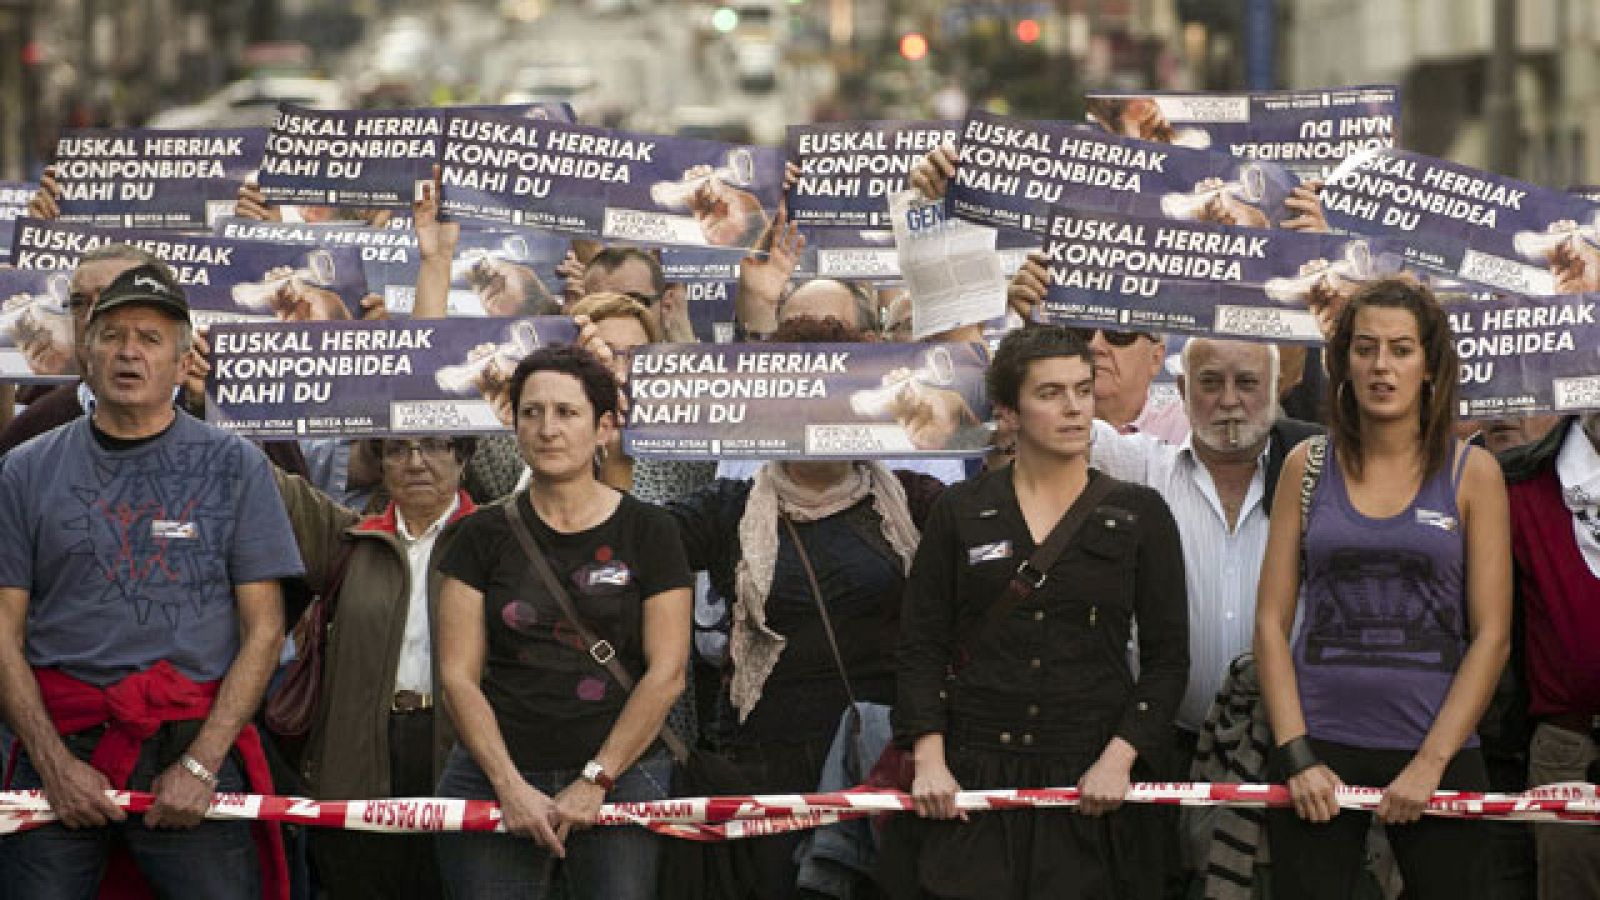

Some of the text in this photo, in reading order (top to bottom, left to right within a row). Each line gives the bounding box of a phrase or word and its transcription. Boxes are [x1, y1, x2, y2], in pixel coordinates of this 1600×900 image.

[275, 113, 443, 136] USKAL HERRIA
[1300, 115, 1393, 138] NAHI DU
[56, 137, 243, 156] EUSKAL HERRIAK
[448, 117, 655, 162] EUSKAL HERRIAK
[800, 129, 956, 154] EUSKAL HERR
[965, 120, 1168, 173] EUSKAL HERRIAK
[55, 159, 226, 179] KONPONBIDEA
[327, 160, 362, 179] DU
[444, 141, 630, 184] KONPONBIDEA
[800, 154, 920, 176] KONPON
[959, 144, 1141, 194] KONPONBIDEA
[59, 181, 115, 201] NAHI
[121, 181, 155, 201] DU
[441, 166, 551, 198] NAHI DU
[797, 178, 860, 197] NAHI
[955, 166, 1063, 204] NAHI DU
[1422, 166, 1528, 211] HERRIAK
[1319, 189, 1421, 231] NAHI DU
[1341, 171, 1497, 229] ONPONBIDEA
[223, 223, 419, 248] EUSKAL HERRIA
[1051, 216, 1146, 246] EUSKAL
[1155, 229, 1269, 259] HERRIAK
[1048, 240, 1242, 281] KONPONBIDEA
[1048, 266, 1160, 297] NAHI DU
[1481, 303, 1596, 331] HERRIAK
[214, 328, 435, 354] EUSKAL HERRIAK
[1456, 330, 1576, 359] ONBIDEA
[214, 354, 413, 379] KONPONBIDEA
[631, 351, 848, 374] EUSKAL HERRIAK
[216, 382, 332, 404] NAHI DU
[631, 378, 826, 399] KONPONBIDEA
[631, 403, 746, 424] NAHI DU
